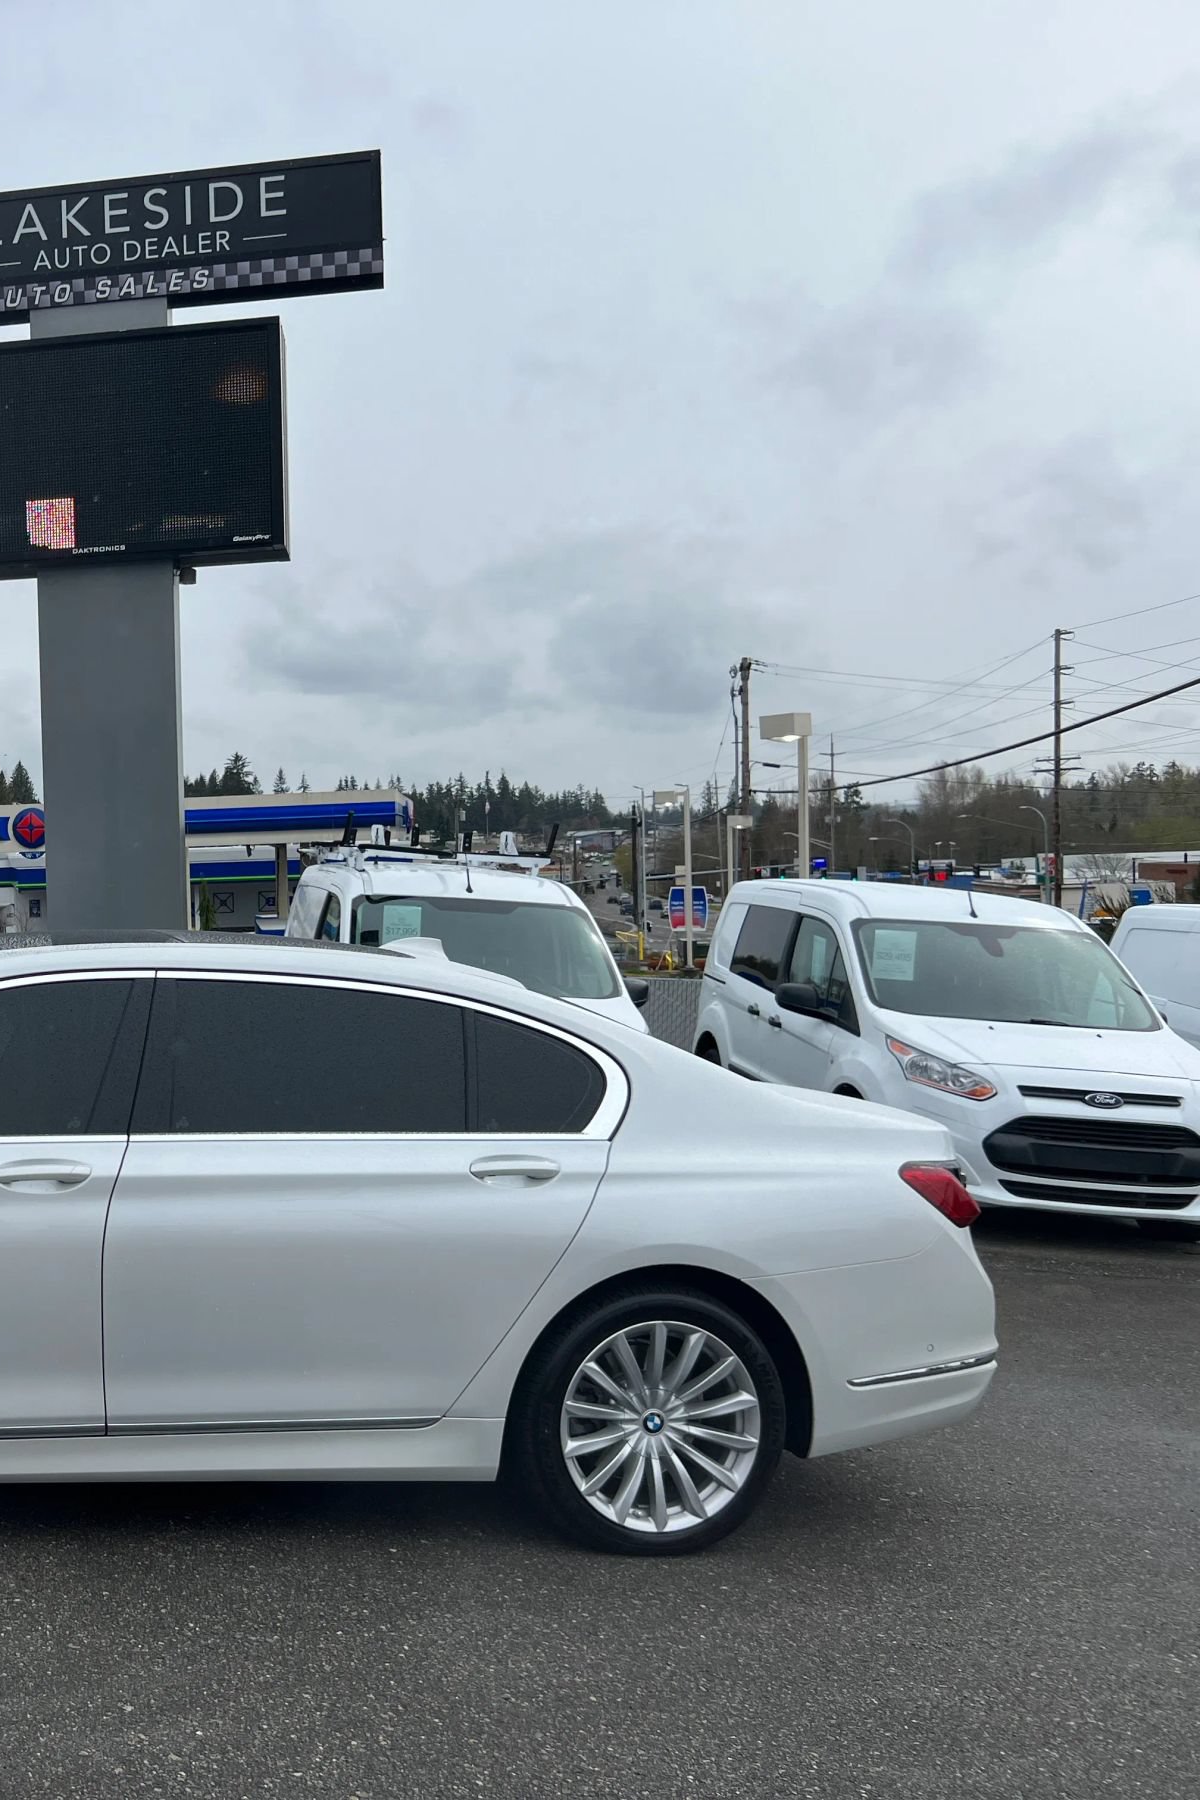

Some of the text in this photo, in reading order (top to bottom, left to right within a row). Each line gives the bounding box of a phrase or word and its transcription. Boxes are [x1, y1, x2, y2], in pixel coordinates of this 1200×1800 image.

[33, 231, 231, 271] AUTO DEALER
[96, 269, 210, 301] SALES
[72, 545, 126, 554] DAKTRONICS
[1094, 1095, 1116, 1104] Ford
